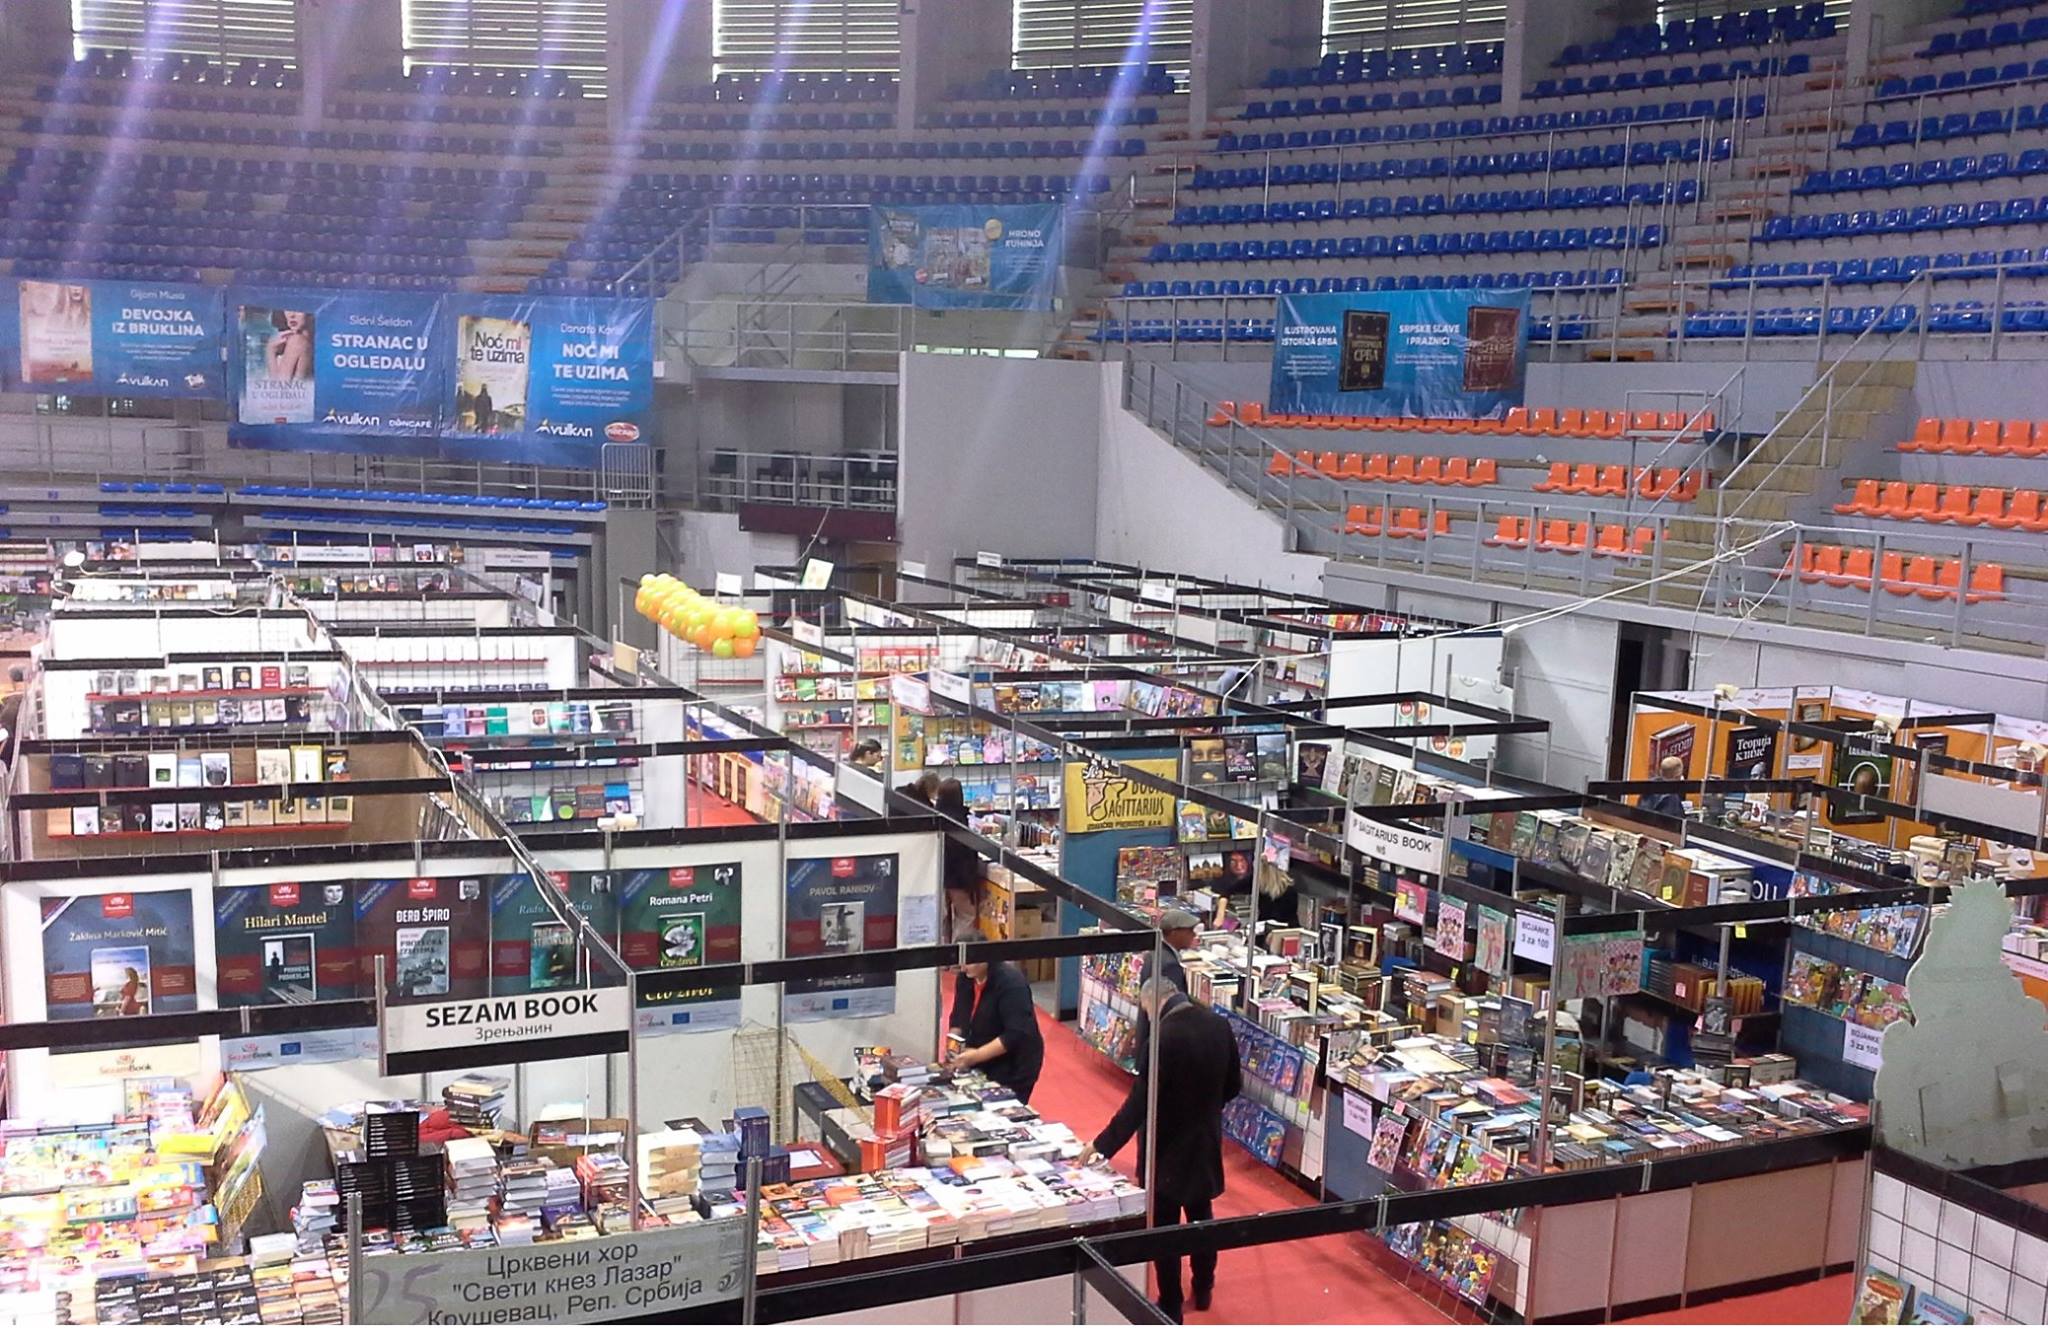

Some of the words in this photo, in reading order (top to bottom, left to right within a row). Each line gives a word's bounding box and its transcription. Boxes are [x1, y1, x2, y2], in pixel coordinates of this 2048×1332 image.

[1008, 229, 1041, 239] HRONO
[121, 308, 194, 322] DEVOJKA
[349, 314, 377, 326] Sidni
[377, 314, 413, 328] Šeldon
[112, 323, 126, 334] IZ
[128, 323, 205, 337] BRUKLINA
[560, 322, 596, 334] Donato
[1284, 326, 1337, 335] ILUSTROVANA
[1399, 324, 1432, 334] SRPSKE
[331, 334, 413, 350] STRANAC
[416, 336, 428, 351] U
[475, 331, 503, 350] Noć
[505, 336, 522, 350] mi
[1281, 337, 1316, 347] ISTORIJA
[1316, 337, 1338, 346] SRBA
[470, 347, 483, 362] te
[486, 348, 525, 364] uzima
[562, 341, 597, 359] NOĆ
[601, 346, 619, 360] MI
[333, 354, 426, 371] OGLEDALU
[552, 364, 574, 378] TE
[576, 365, 630, 381] UZIMA
[129, 375, 169, 387] vulkan
[336, 412, 380, 427] vulkan
[550, 423, 593, 438] vulkan
[1098, 797, 1164, 820] SAGITTARIUS
[1402, 836, 1432, 853] BOOK
[809, 886, 838, 897] PAVOL
[649, 894, 688, 907] Romana
[689, 892, 714, 904] Petri
[244, 914, 281, 929] Hilari
[284, 911, 328, 926] Mantel
[422, 906, 450, 922] ŠPIRO
[103, 927, 145, 940] Marković
[145, 926, 169, 937] Mitić
[1537, 937, 1550, 949] 100
[426, 1001, 517, 1028] SEZAM
[524, 994, 599, 1020] BOOK
[475, 1024, 553, 1042] Зрењанин
[1866, 1045, 1880, 1056] 100
[487, 1251, 590, 1279] Црквени
[598, 1243, 639, 1264] хор
[452, 1281, 537, 1303] "Свети
[545, 1275, 596, 1293] кнез
[603, 1255, 682, 1287] Лазар"
[428, 1303, 558, 1325] Крушевац,
[567, 1295, 616, 1316] Реп.
[625, 1278, 703, 1308] Србија
